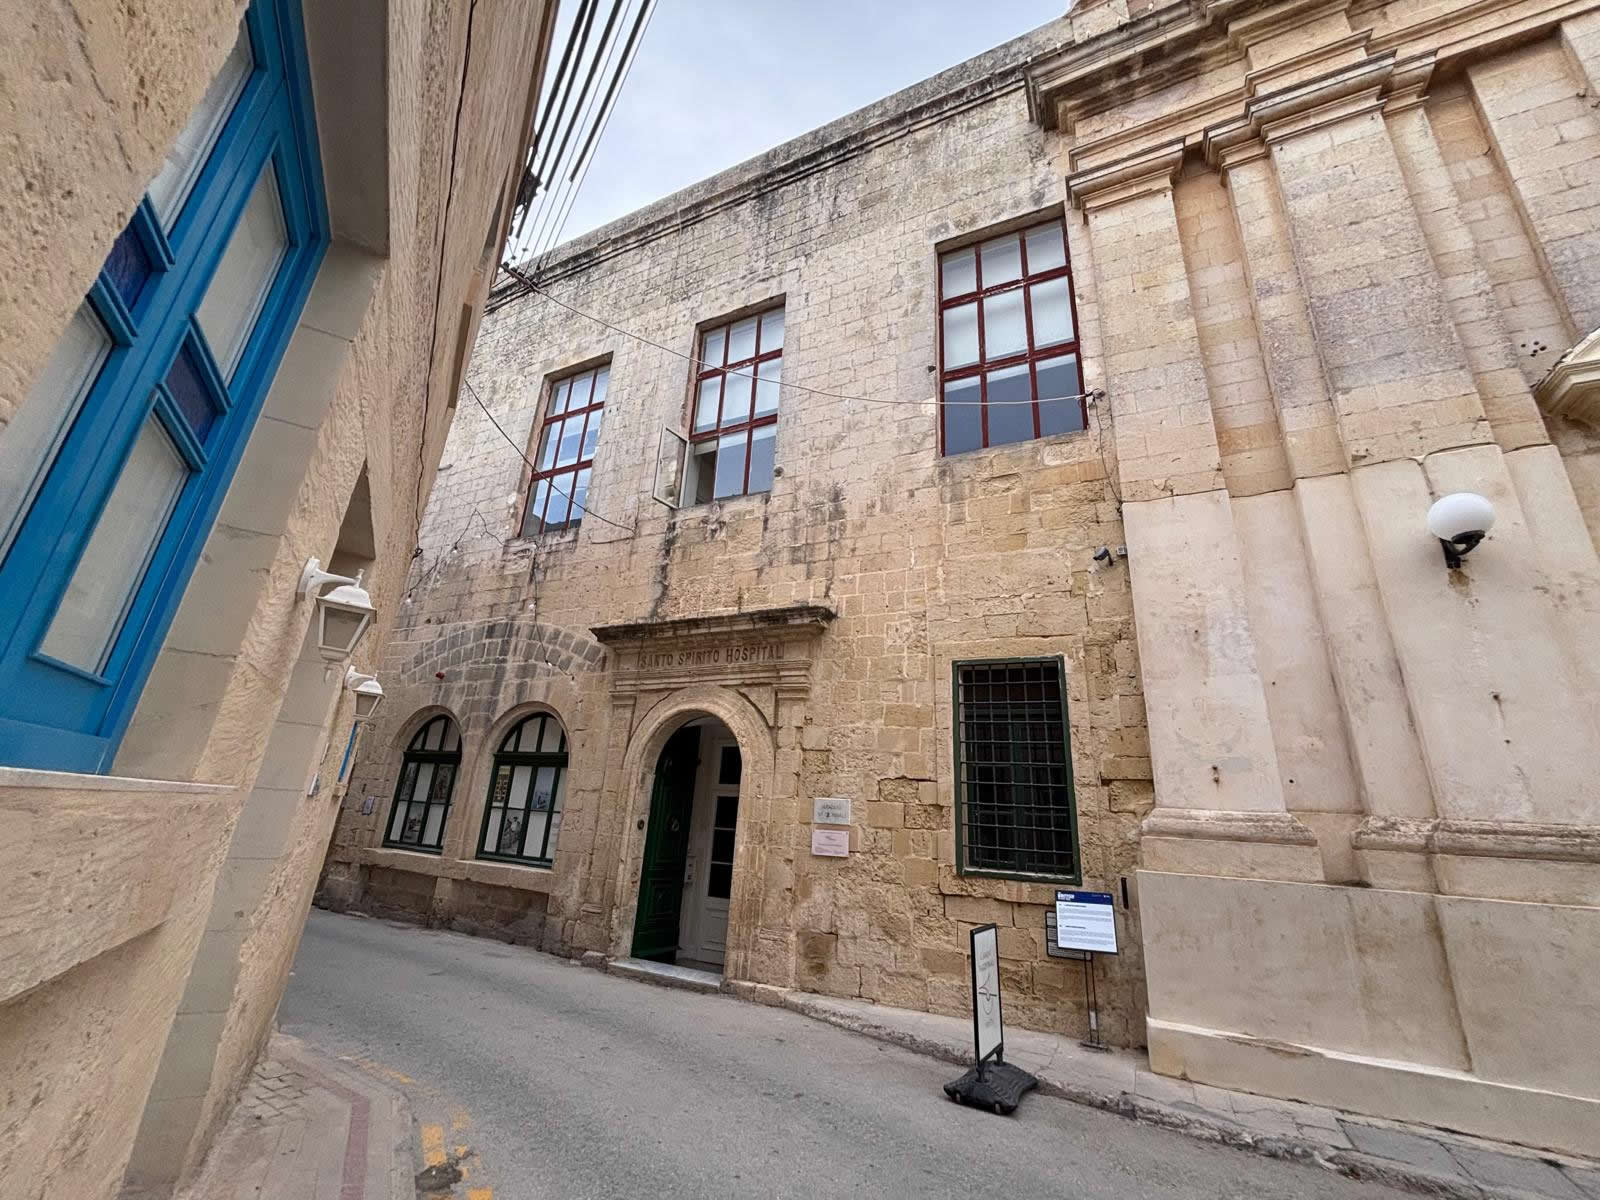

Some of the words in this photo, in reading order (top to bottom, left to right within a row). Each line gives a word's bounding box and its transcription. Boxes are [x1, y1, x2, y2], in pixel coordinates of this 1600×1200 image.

[640, 654, 674, 668] SANTO
[678, 651, 720, 665] SPIRITO
[726, 646, 783, 663] HOSPITAL
